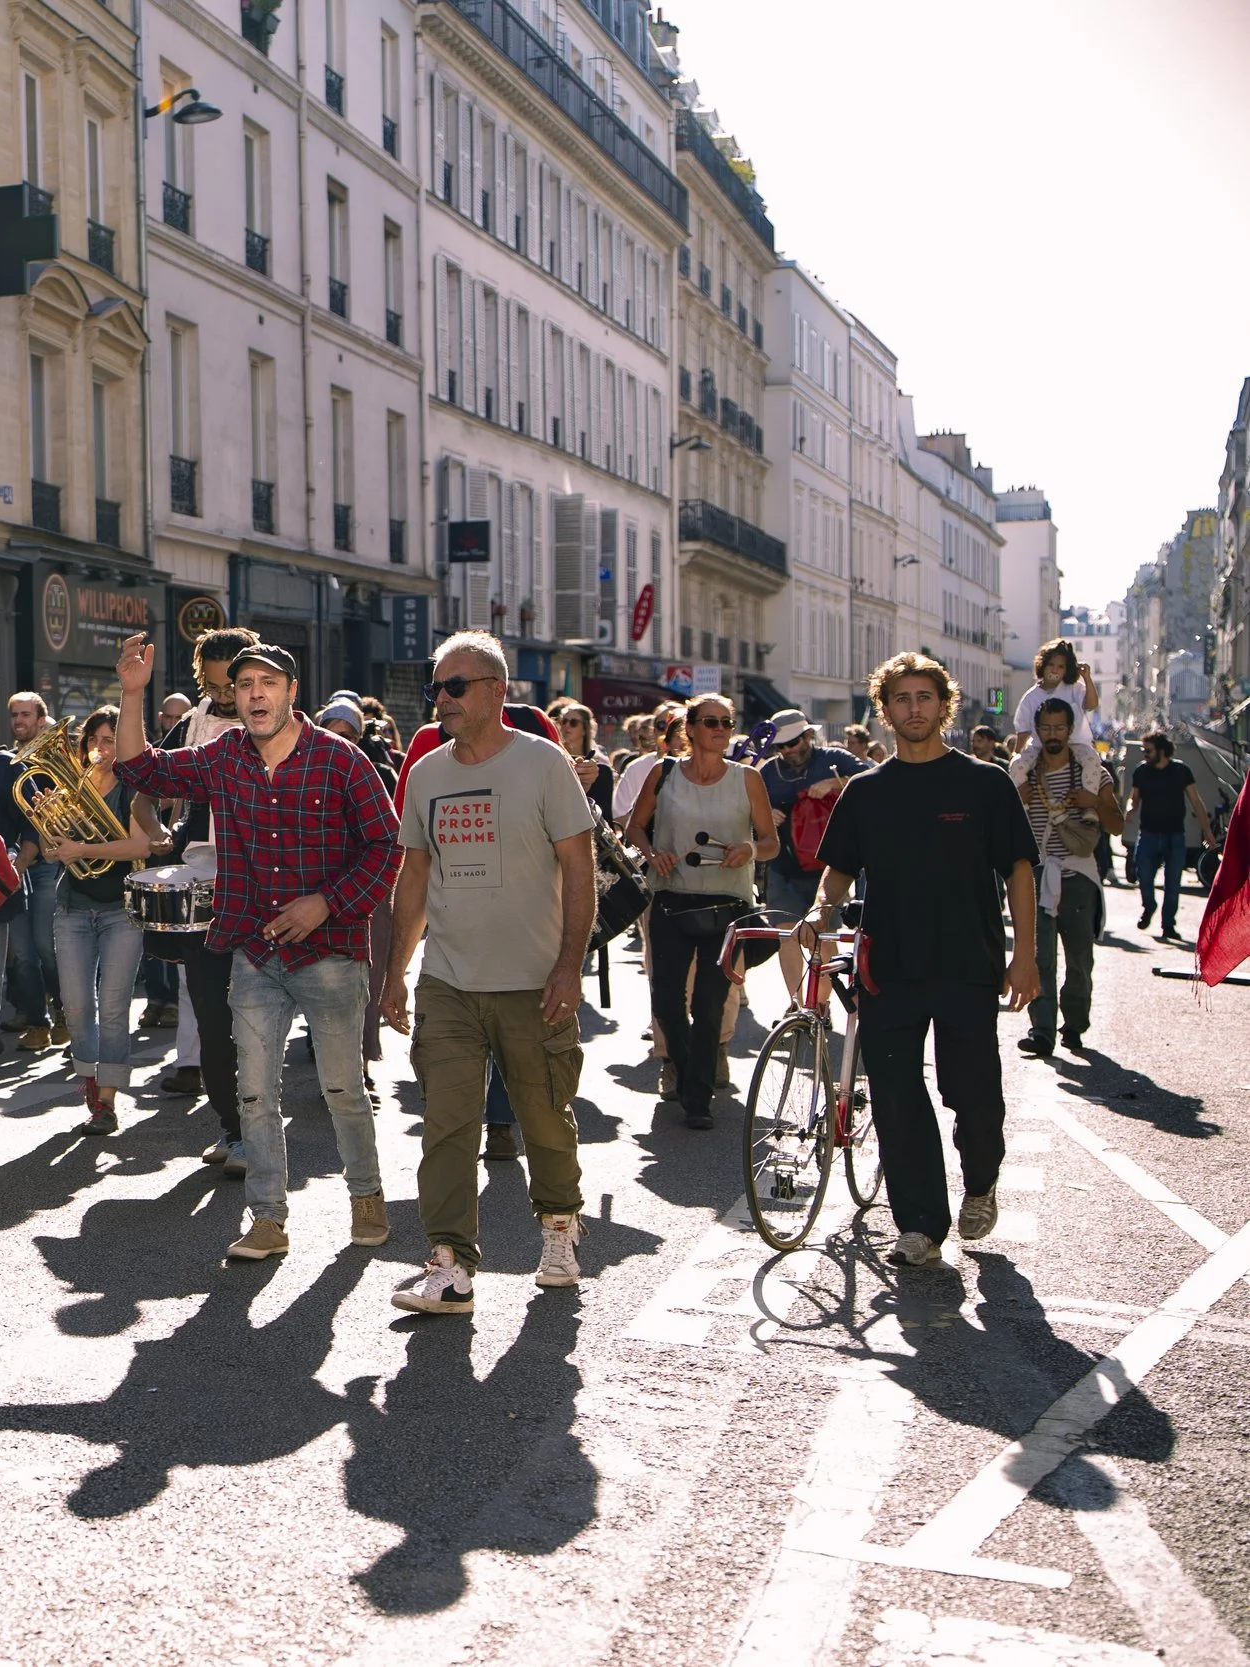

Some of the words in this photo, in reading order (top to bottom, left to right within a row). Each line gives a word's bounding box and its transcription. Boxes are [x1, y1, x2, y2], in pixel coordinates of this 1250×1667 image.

[77, 587, 149, 625] WILLIPHONE
[442, 804, 491, 815] VASTE
[439, 818, 493, 829] PROG-
[438, 832, 495, 844] RAMME
